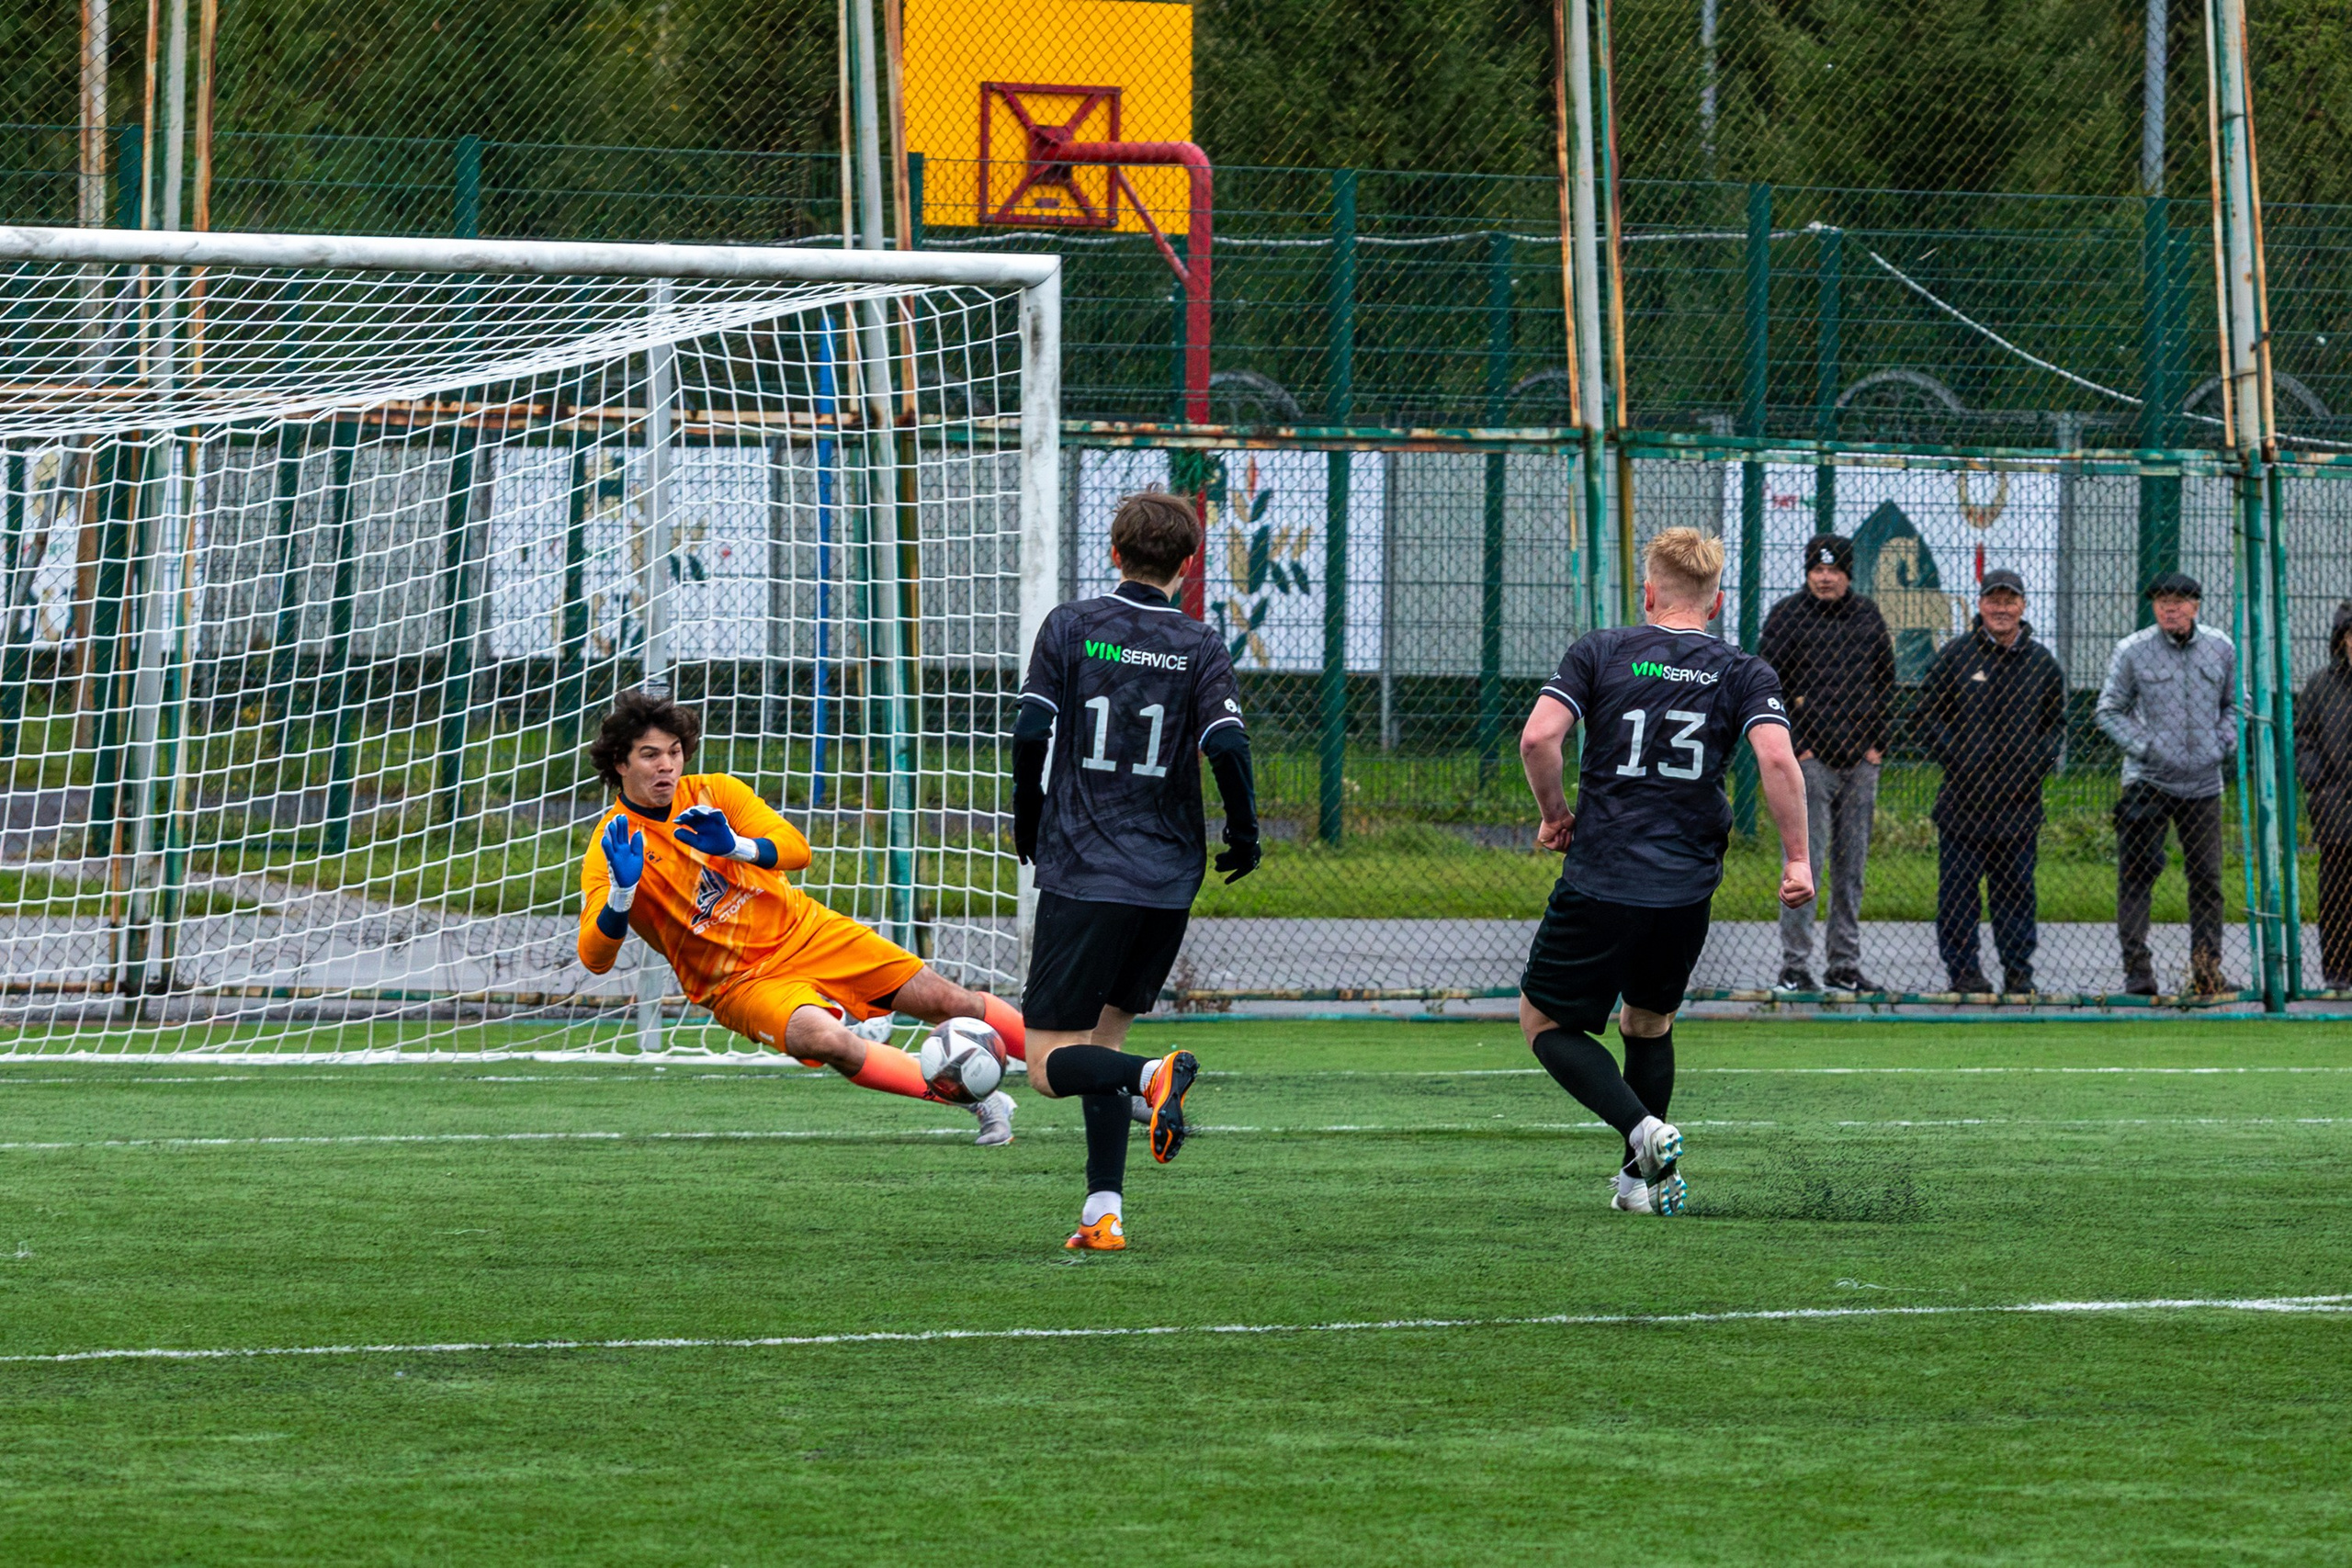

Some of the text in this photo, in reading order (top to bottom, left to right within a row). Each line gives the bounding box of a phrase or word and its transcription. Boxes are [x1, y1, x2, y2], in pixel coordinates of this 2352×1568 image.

[1085, 639, 1188, 671] VINSERVICE
[1632, 661, 1719, 684] VINSERVICE
[1082, 695, 1167, 777] 11
[1616, 708, 1706, 780] 13
